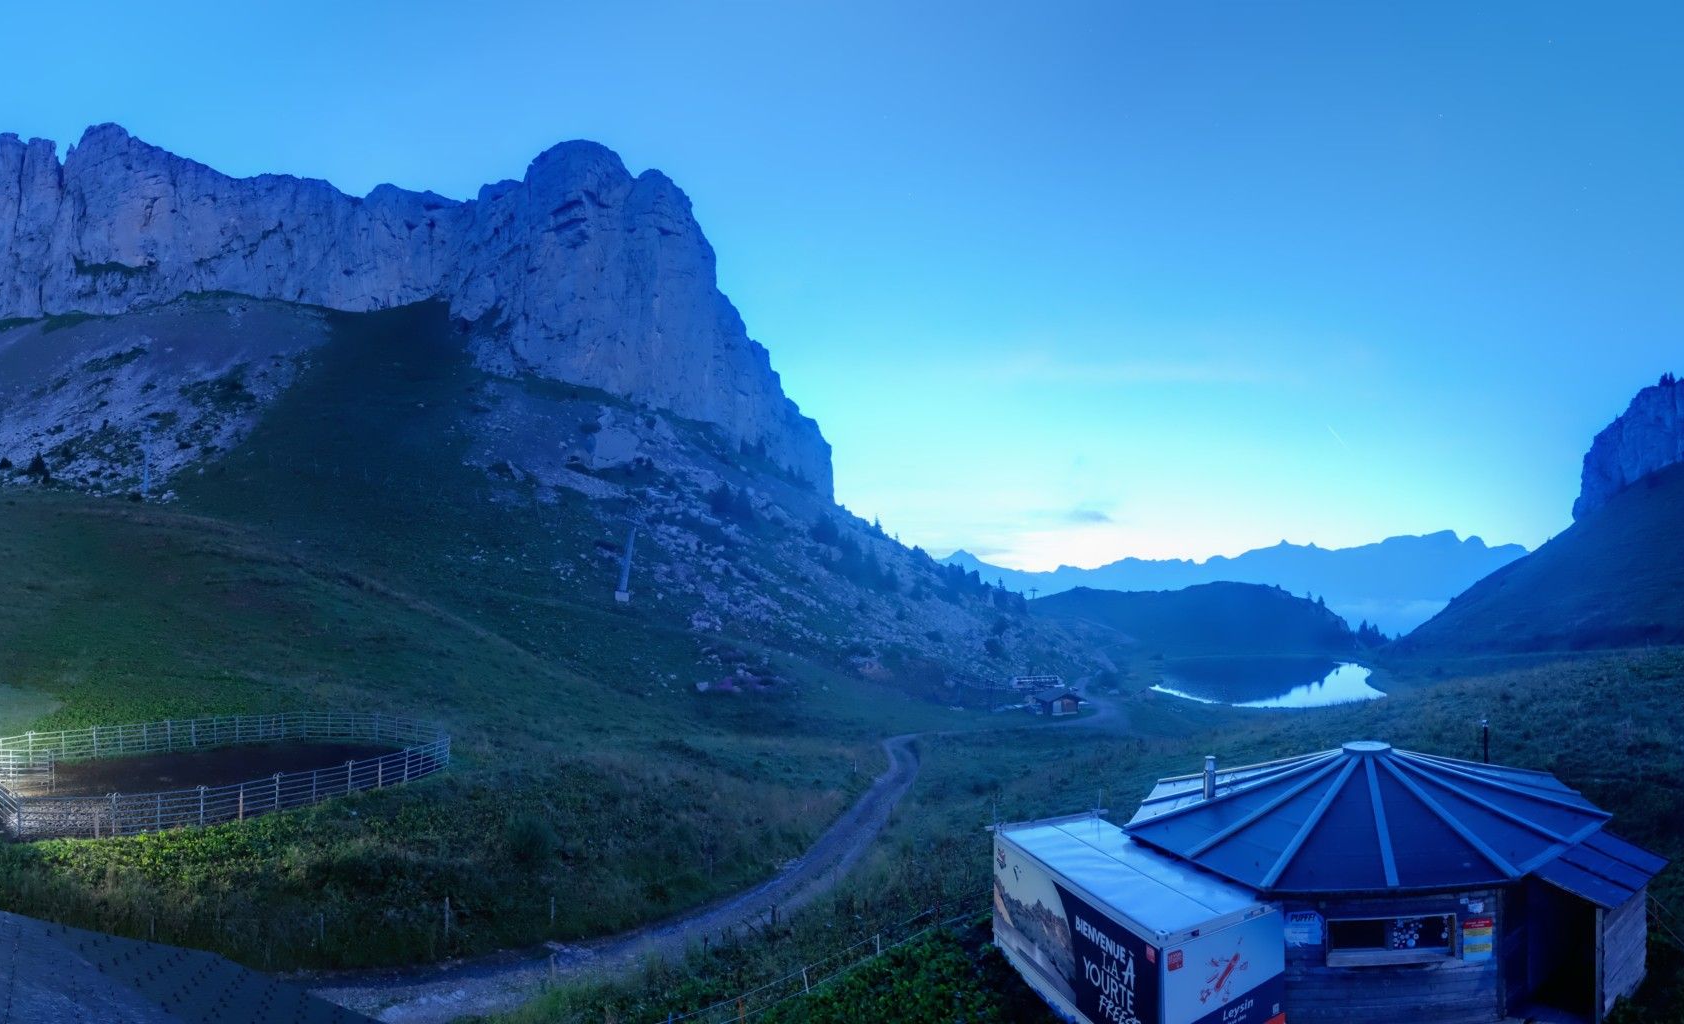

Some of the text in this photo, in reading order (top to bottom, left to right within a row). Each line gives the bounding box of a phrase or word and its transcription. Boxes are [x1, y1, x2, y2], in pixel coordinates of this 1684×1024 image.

[1076, 915, 1135, 990] BIENVENUE À
[1101, 951, 1121, 981] LA
[1083, 955, 1134, 1015] YOURTE
[1223, 999, 1254, 1021] Leysin
